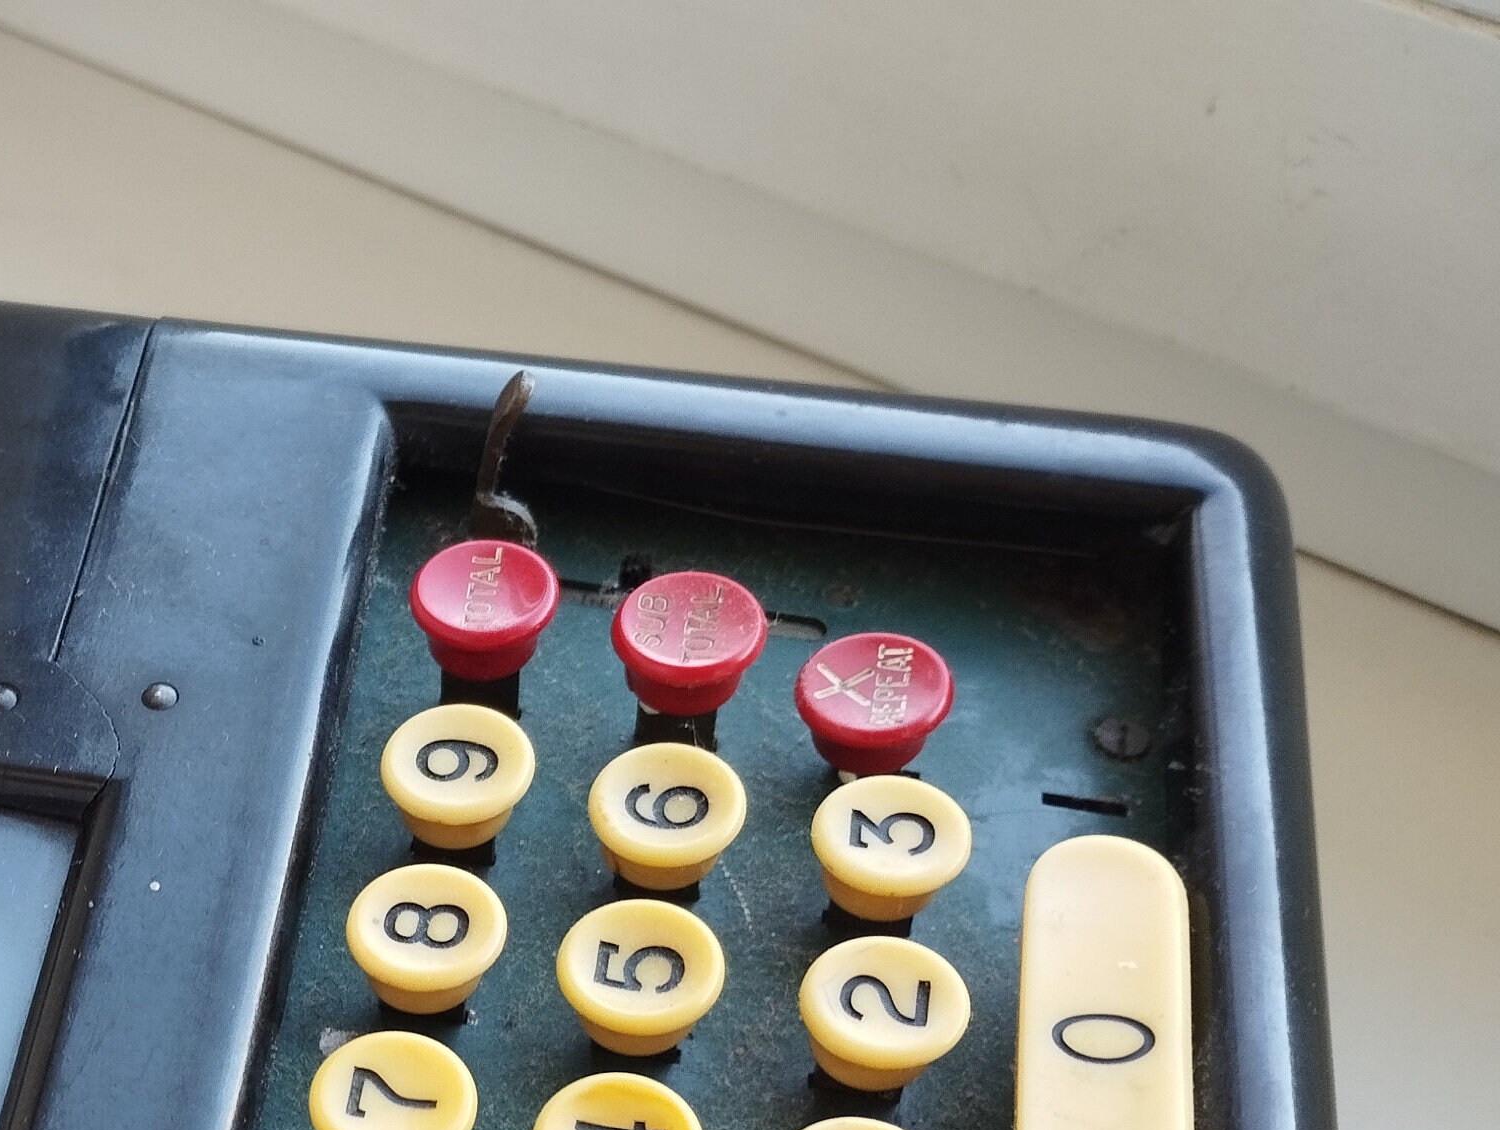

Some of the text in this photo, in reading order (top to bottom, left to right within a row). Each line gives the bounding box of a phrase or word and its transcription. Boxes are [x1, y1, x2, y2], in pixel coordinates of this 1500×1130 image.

[461, 546, 503, 628] TOTAL
[634, 592, 668, 649] SUB
[680, 582, 724, 664] TOTAL
[869, 643, 914, 725] REPEAT
[415, 738, 499, 782] 9
[625, 783, 710, 830] 6
[851, 808, 936, 855] 3
[383, 901, 470, 949] 8
[596, 940, 686, 993] 5
[840, 974, 932, 1027] 2
[1052, 1013, 1156, 1065] 0
[348, 1065, 438, 1118] 7
